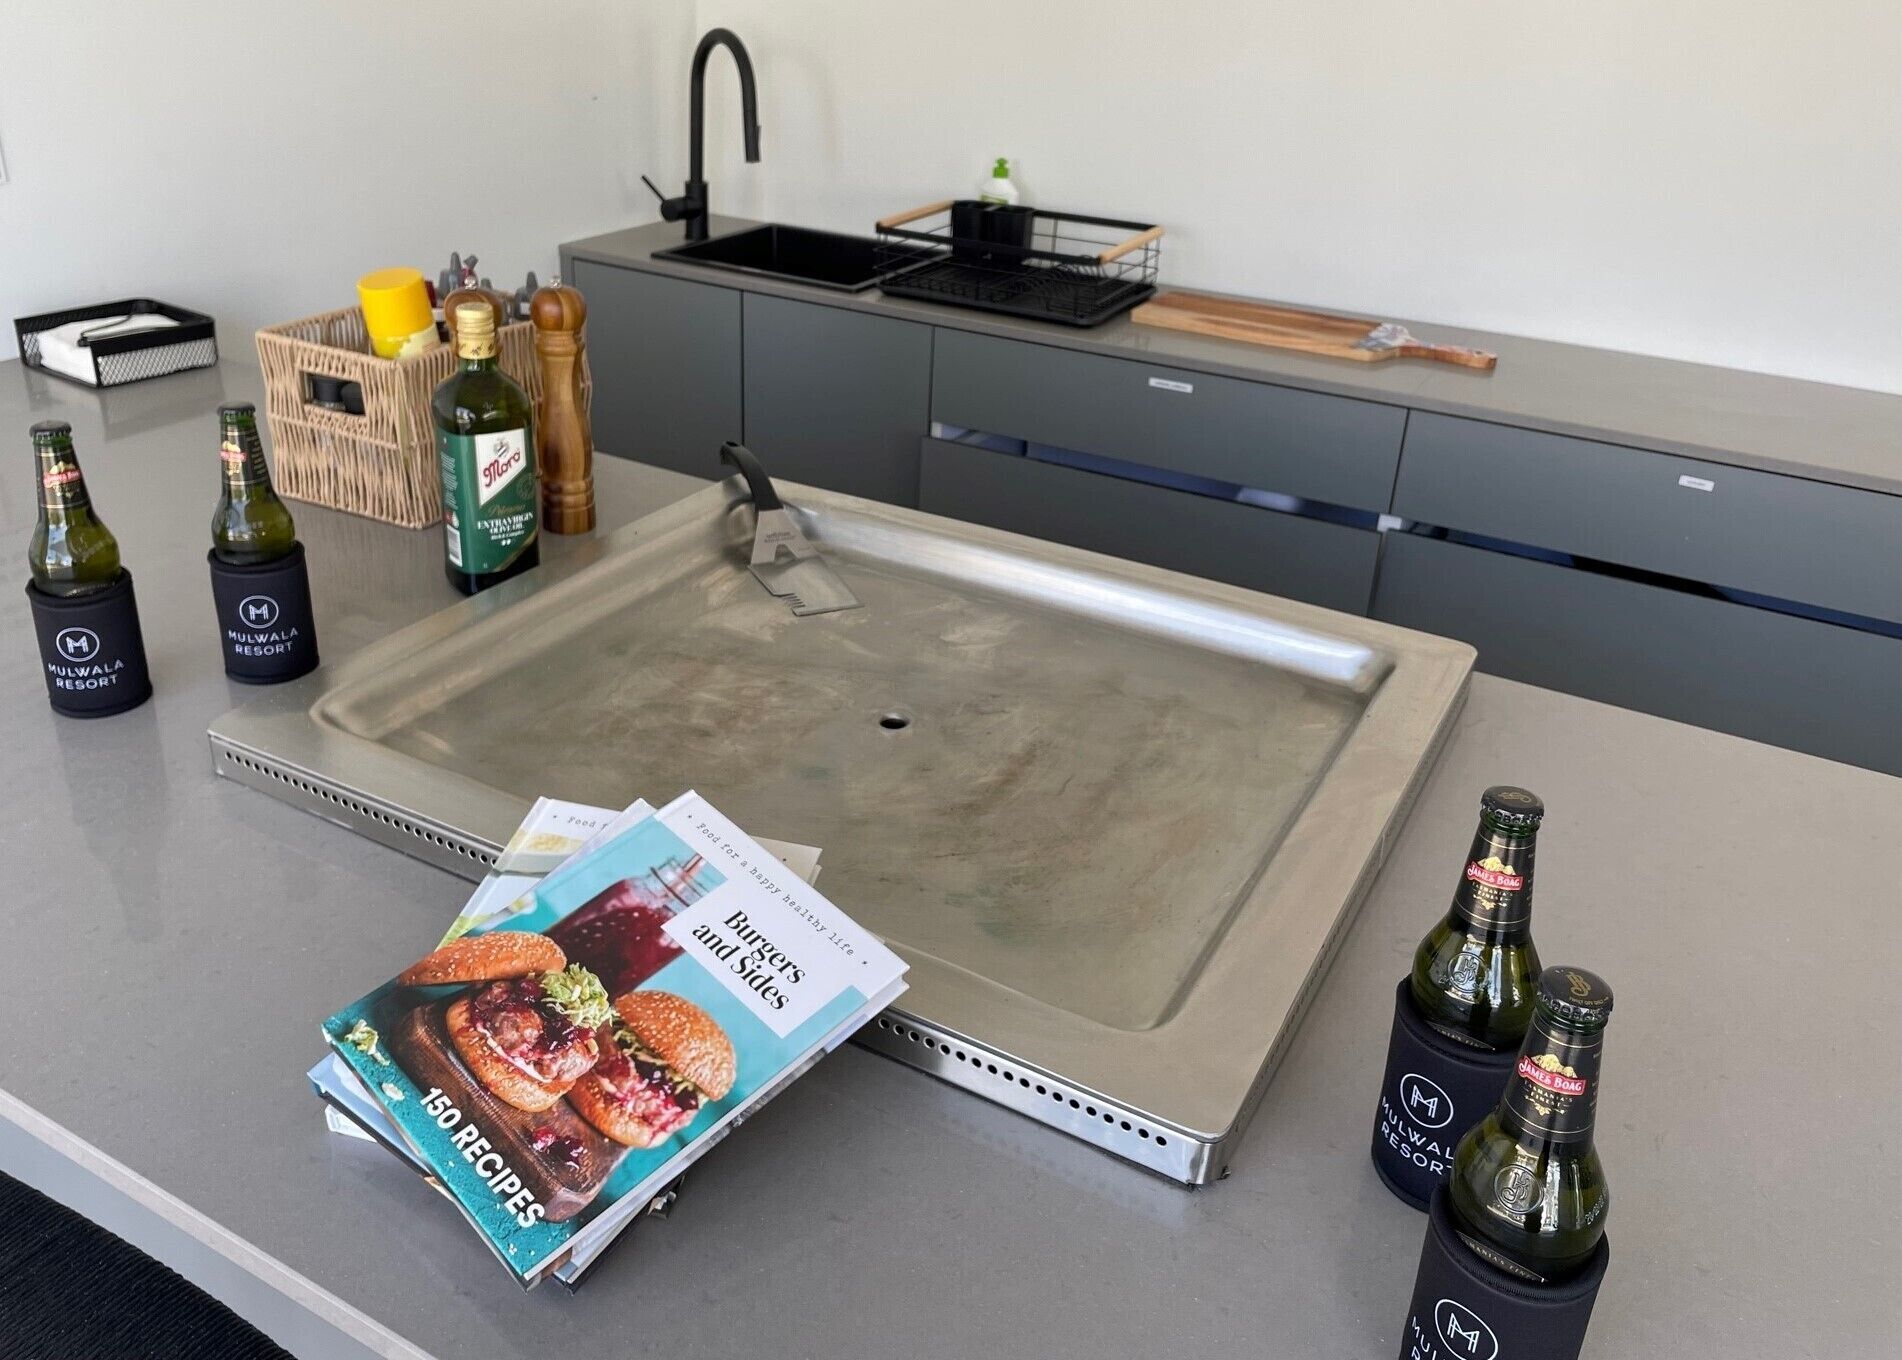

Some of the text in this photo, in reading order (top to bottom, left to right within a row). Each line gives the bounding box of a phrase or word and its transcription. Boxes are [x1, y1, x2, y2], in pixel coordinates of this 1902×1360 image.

[483, 450, 521, 488] Moro
[228, 627, 299, 644] MULWALA
[235, 641, 293, 657] RESORT
[47, 659, 125, 678] MULWALA
[56, 673, 118, 690] RESORT
[568, 815, 597, 828] Food
[696, 822, 855, 957] Food for a happy healthy life
[1467, 864, 1521, 888] JAMES BOAG
[723, 909, 806, 984] Burgers
[692, 924, 790, 1010] and Sides
[1518, 1059, 1583, 1092] JAMES BOAG
[1523, 1079, 1574, 1103] TASMANIA'S
[1530, 1091, 1563, 1108] FINEST
[1381, 1095, 1455, 1161] MULWAL
[419, 1087, 546, 1229] 150 RECIPES
[1381, 1120, 1453, 1176] RESOR
